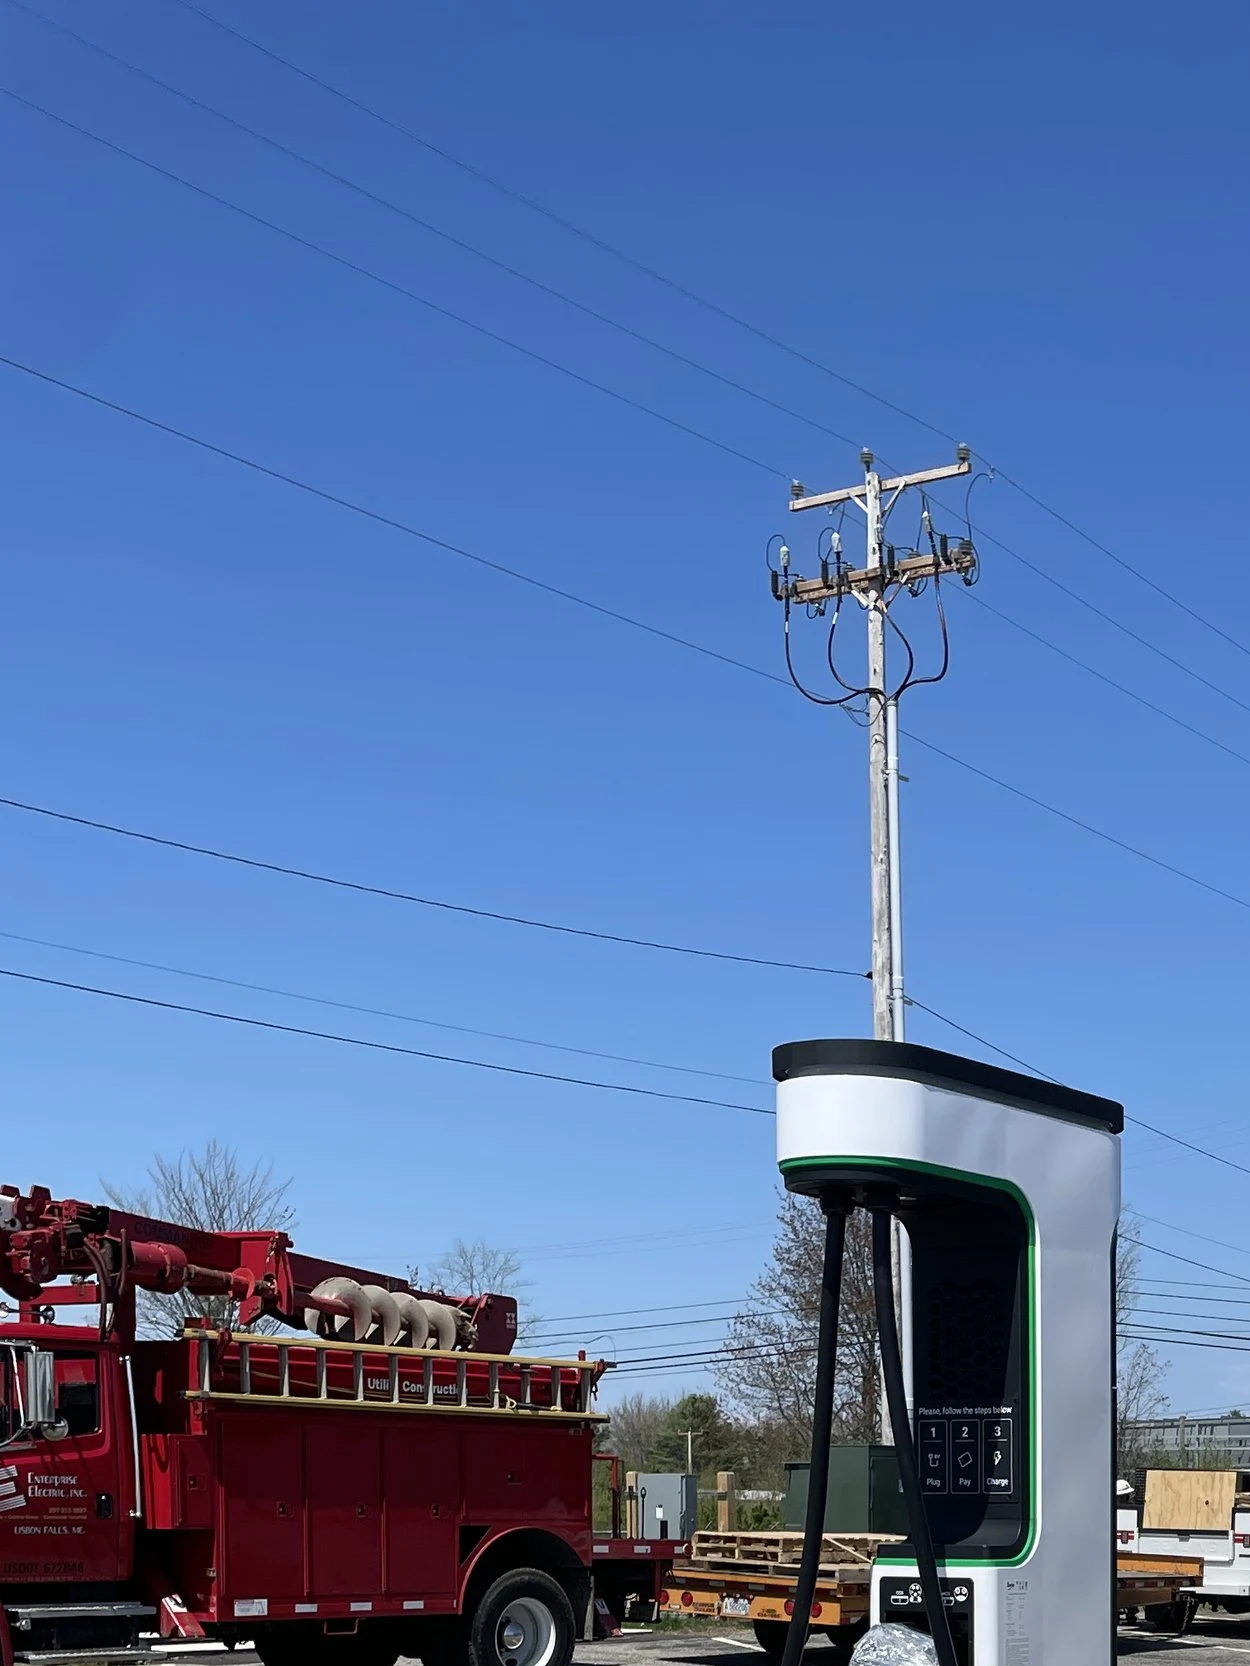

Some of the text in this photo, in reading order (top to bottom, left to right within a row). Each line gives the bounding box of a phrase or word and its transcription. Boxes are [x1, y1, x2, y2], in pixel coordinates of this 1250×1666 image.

[367, 1378, 468, 1395] Utili Conructi
[918, 1407, 941, 1416] Please,
[942, 1406, 961, 1415] follow
[974, 1407, 992, 1416] steps
[993, 1406, 1012, 1414] below
[930, 1427, 936, 1438] 1
[961, 1426, 969, 1437] 2
[994, 1426, 1001, 1437] 3
[926, 1478, 941, 1487] Plug
[959, 1478, 971, 1487] Pay
[986, 1477, 1009, 1487] Charge
[14, 1526, 41, 1535] LISBON
[3, 1562, 39, 1574] USDOT
